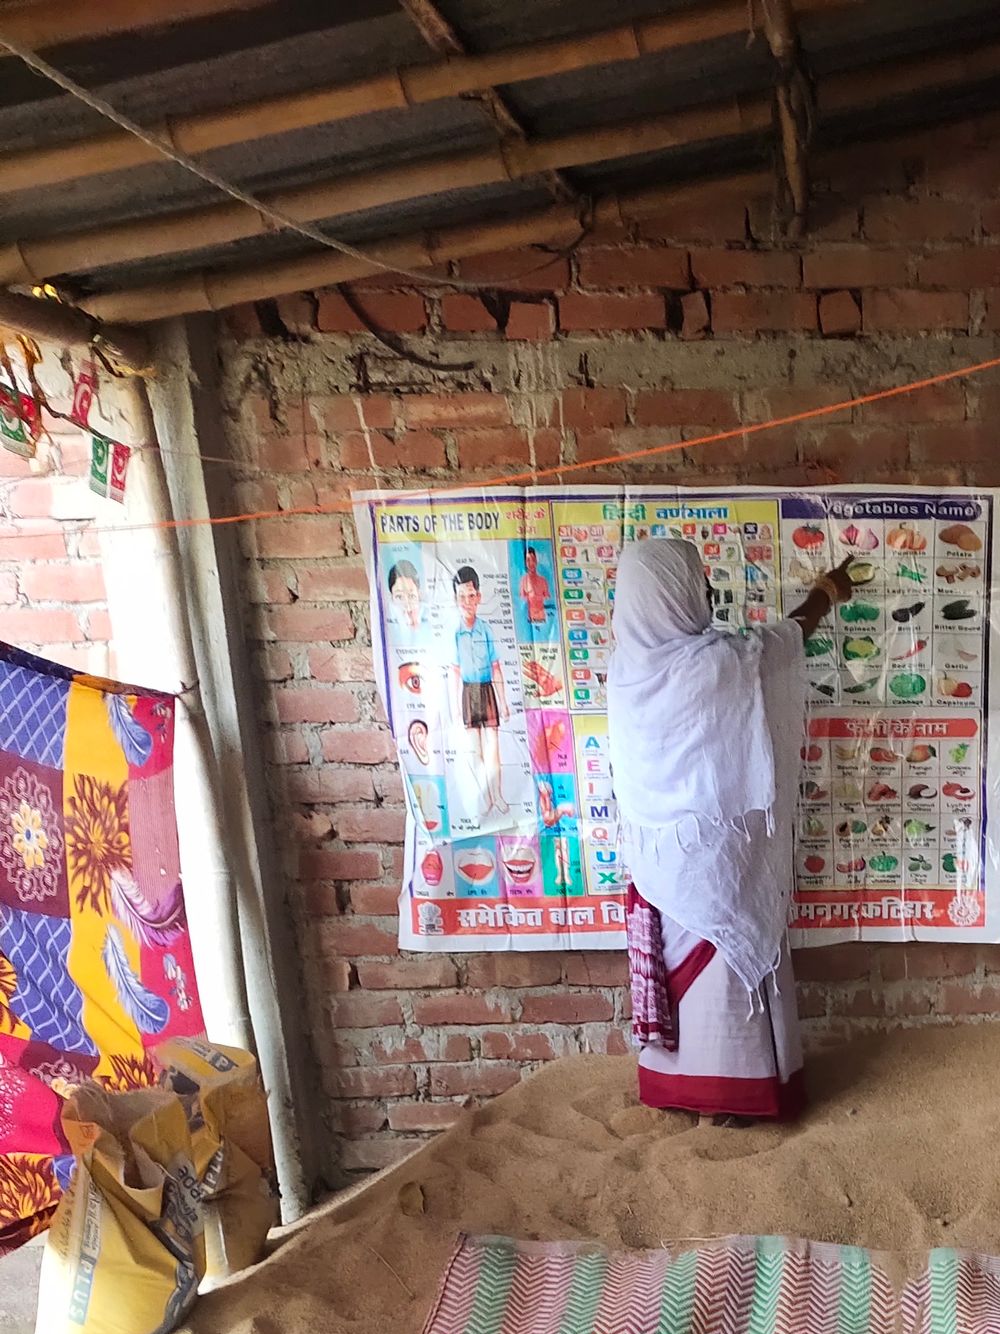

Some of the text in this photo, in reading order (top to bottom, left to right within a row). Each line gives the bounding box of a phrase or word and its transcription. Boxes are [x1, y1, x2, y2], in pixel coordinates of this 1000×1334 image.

[602, 504, 729, 521] हिन्दी वर्णमाला
[824, 503, 974, 516] Vegetables Name
[381, 512, 500, 533] PARTS OF THE BODY
[916, 722, 949, 735] नाम
[585, 737, 600, 749] A
[587, 760, 600, 772] E
[591, 806, 608, 817] M
[592, 827, 608, 841] Q
[596, 852, 616, 862] U
[599, 873, 617, 884] X
[861, 896, 935, 921] कटिहार
[456, 904, 595, 928] समेकित बाल
